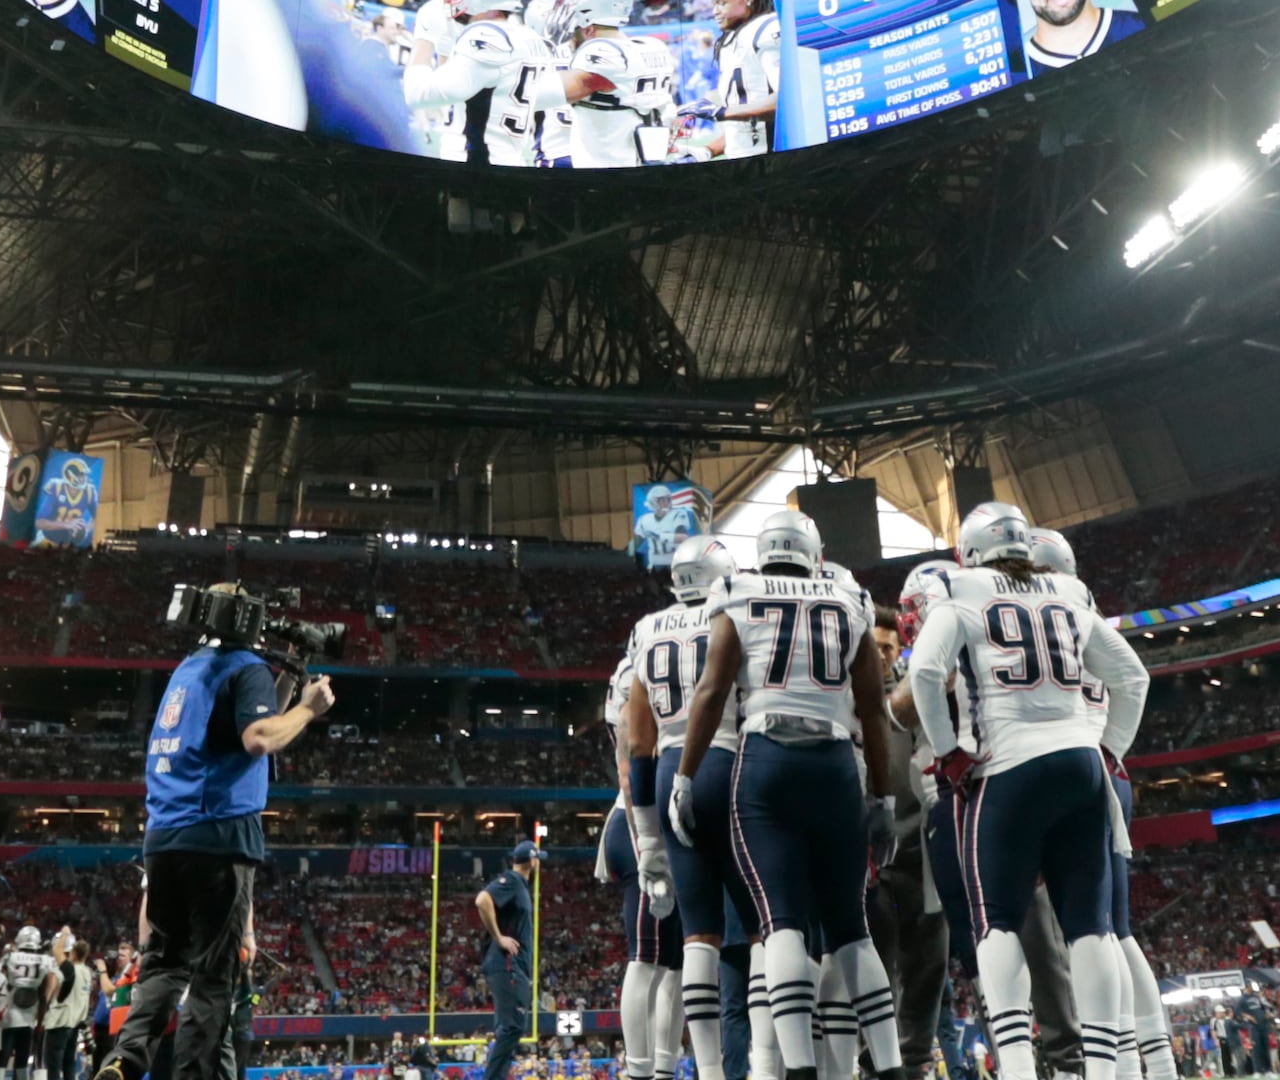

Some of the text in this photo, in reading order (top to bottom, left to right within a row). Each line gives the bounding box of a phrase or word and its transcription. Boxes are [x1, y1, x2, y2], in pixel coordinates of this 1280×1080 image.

[136, 12, 158, 34] BYU
[870, 14, 949, 48] SEASON STATS
[914, 34, 940, 52] YARDS
[960, 12, 997, 33] 4,507
[825, 29, 999, 92] 2,037 RUSH YARDS 2,231
[826, 42, 1003, 107] 6,295 TOTAL YARDS 6,738
[828, 59, 1005, 122] 365 FIRST DOWNS 401
[830, 73, 1008, 137] 31:05 AVG TIME OF POSS. 30:41
[764, 578, 836, 598] BUTLER
[747, 598, 852, 690] 70
[982, 600, 1082, 691] 90
